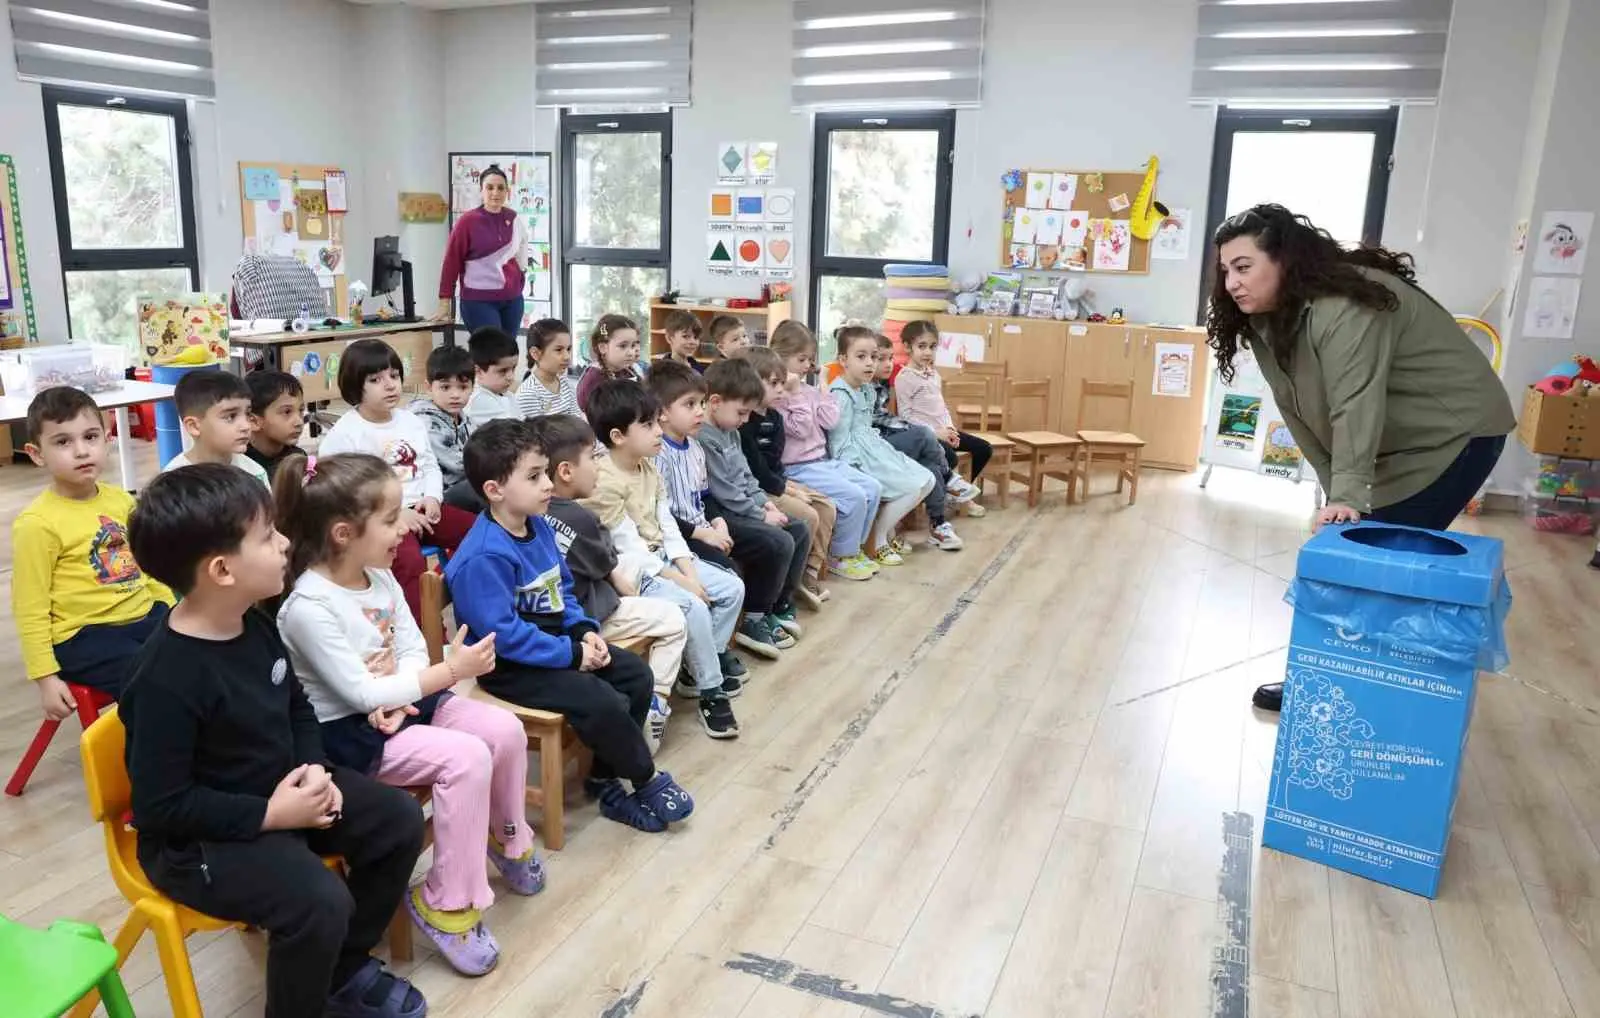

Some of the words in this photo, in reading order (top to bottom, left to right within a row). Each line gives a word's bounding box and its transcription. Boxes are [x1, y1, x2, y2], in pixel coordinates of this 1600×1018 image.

[1265, 466, 1292, 478] windy
[543, 514, 578, 540] MOTION
[1350, 749, 1374, 760] GERİ
[1356, 835, 1385, 848] MADDE
